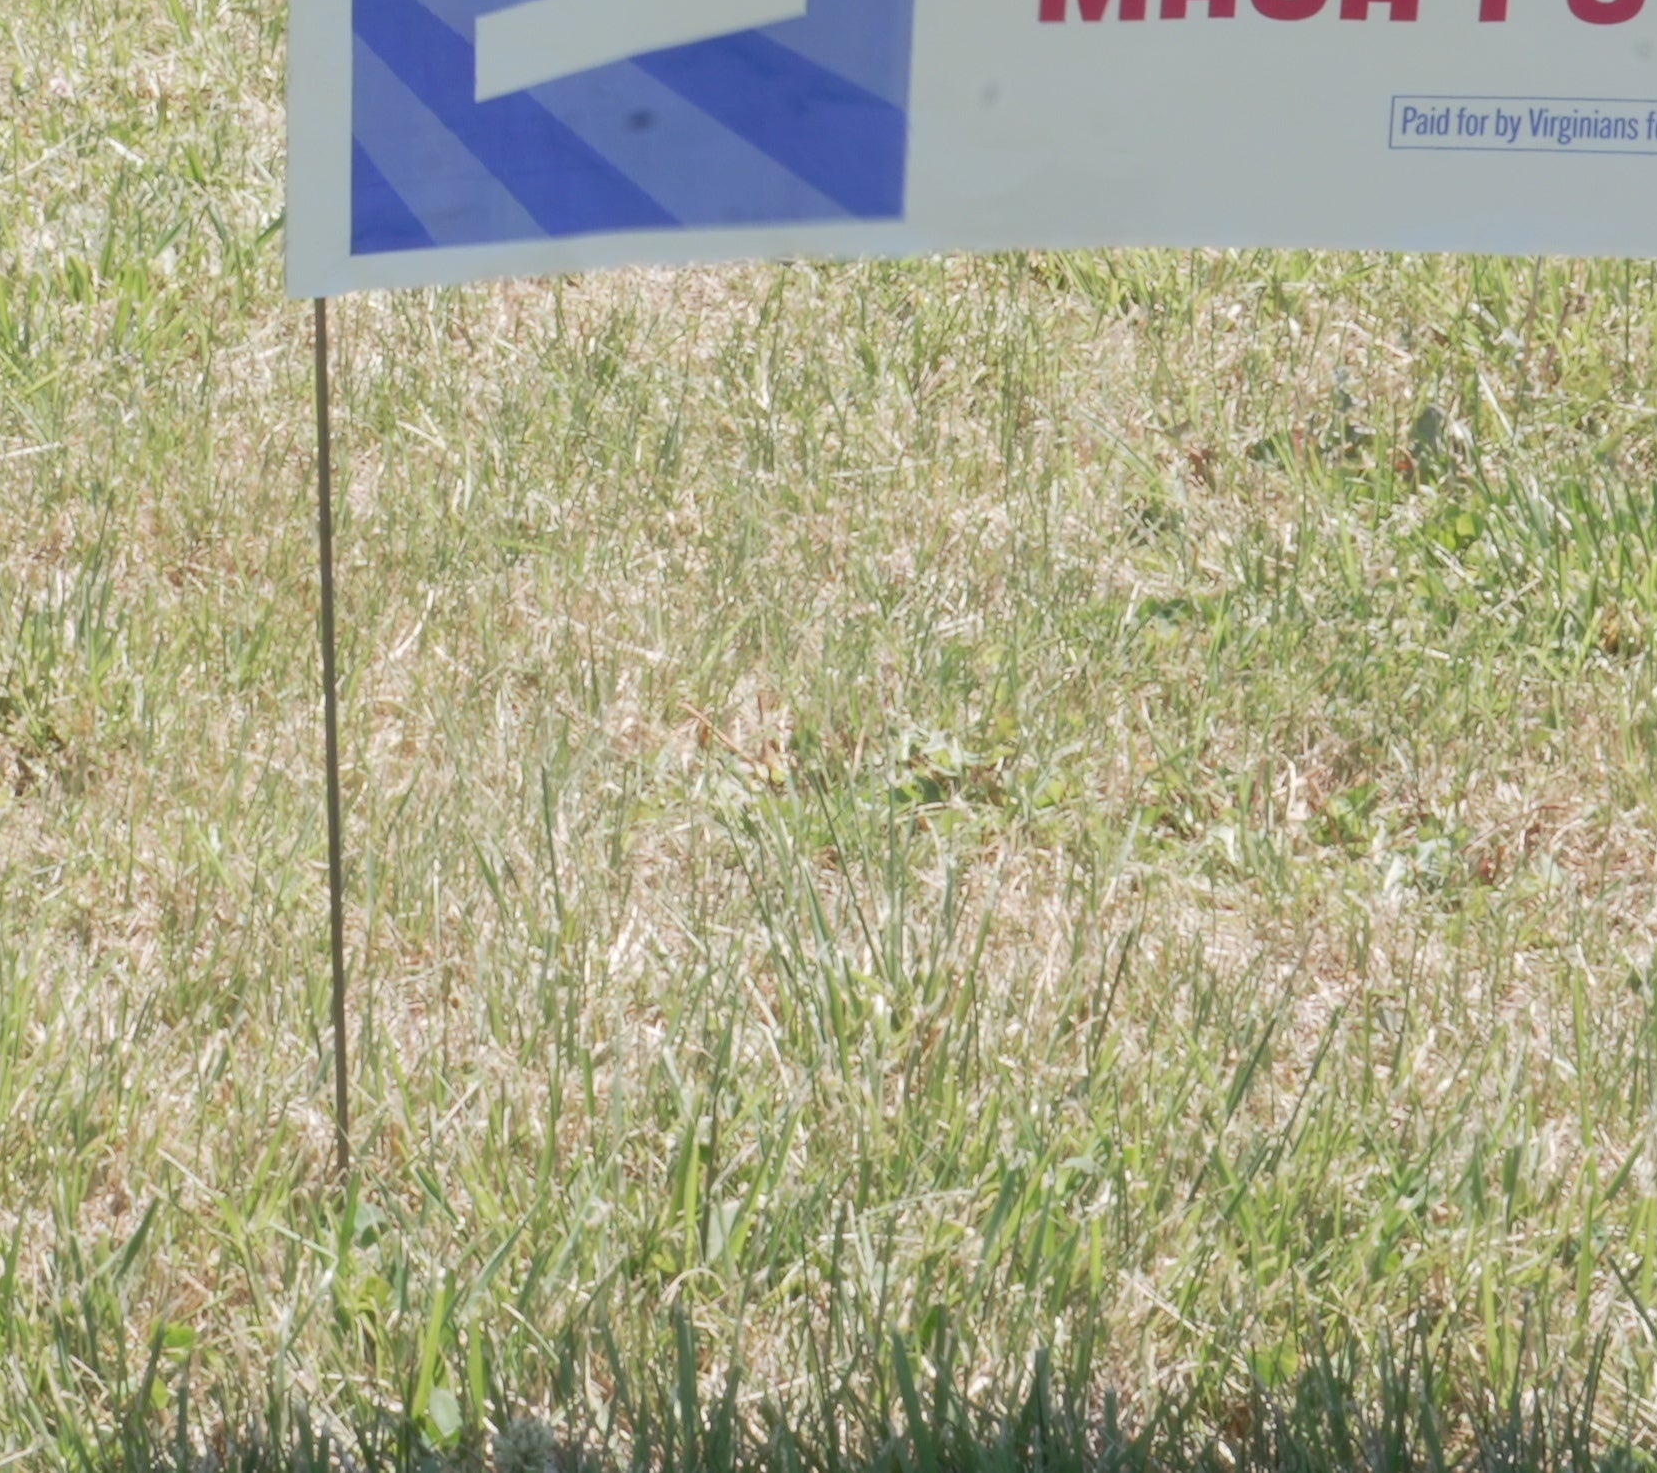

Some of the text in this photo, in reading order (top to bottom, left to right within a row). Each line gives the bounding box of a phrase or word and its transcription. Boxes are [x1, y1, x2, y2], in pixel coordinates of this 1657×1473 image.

[1402, 107, 1449, 135] Paid
[1457, 107, 1490, 136] for
[1496, 108, 1521, 143] by
[1529, 108, 1638, 145] Virginians
